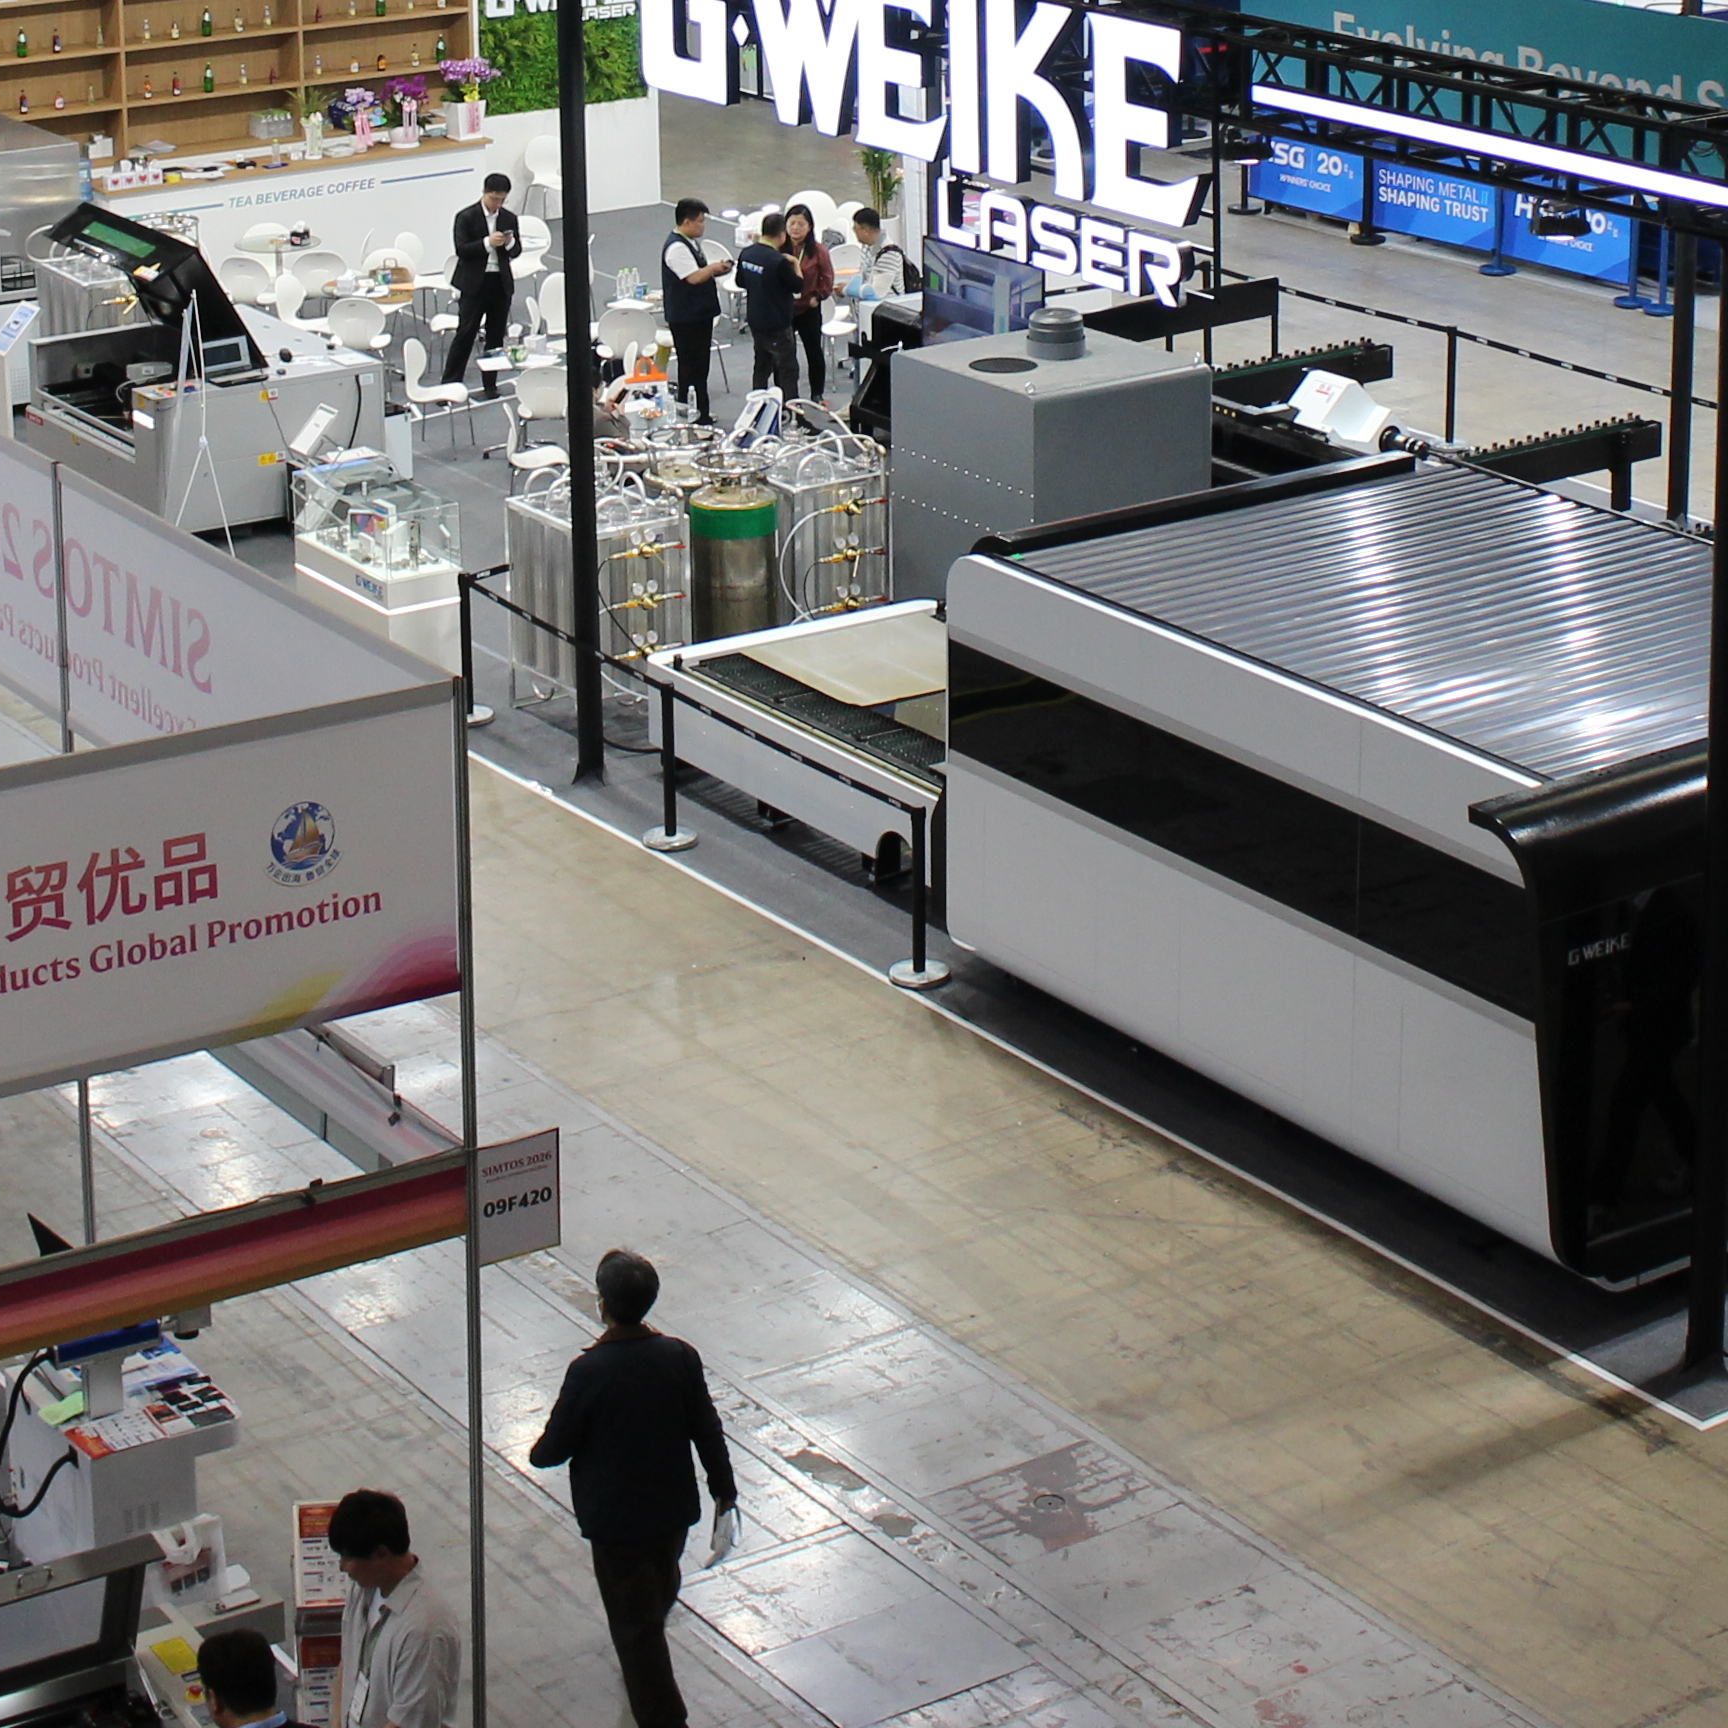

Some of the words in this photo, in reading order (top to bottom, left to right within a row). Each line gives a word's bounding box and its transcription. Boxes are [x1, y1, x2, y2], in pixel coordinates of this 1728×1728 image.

[1316, 151, 1344, 177] 20
[228, 193, 263, 211] TEA
[267, 186, 325, 207] BEVERAGE
[326, 178, 378, 200] COFFEE
[1378, 168, 1437, 196] SHAPING
[1437, 182, 1480, 205] METAL
[1377, 186, 1442, 214] SHAPING
[1442, 198, 1490, 225] TRUST
[935, 177, 1192, 308] LASER
[88, 922, 201, 975] Global
[205, 884, 383, 950] Promotion
[481, 1157, 524, 1178] SIMTOS
[526, 1151, 552, 1167] 2026
[483, 1186, 552, 1218] 09F420
